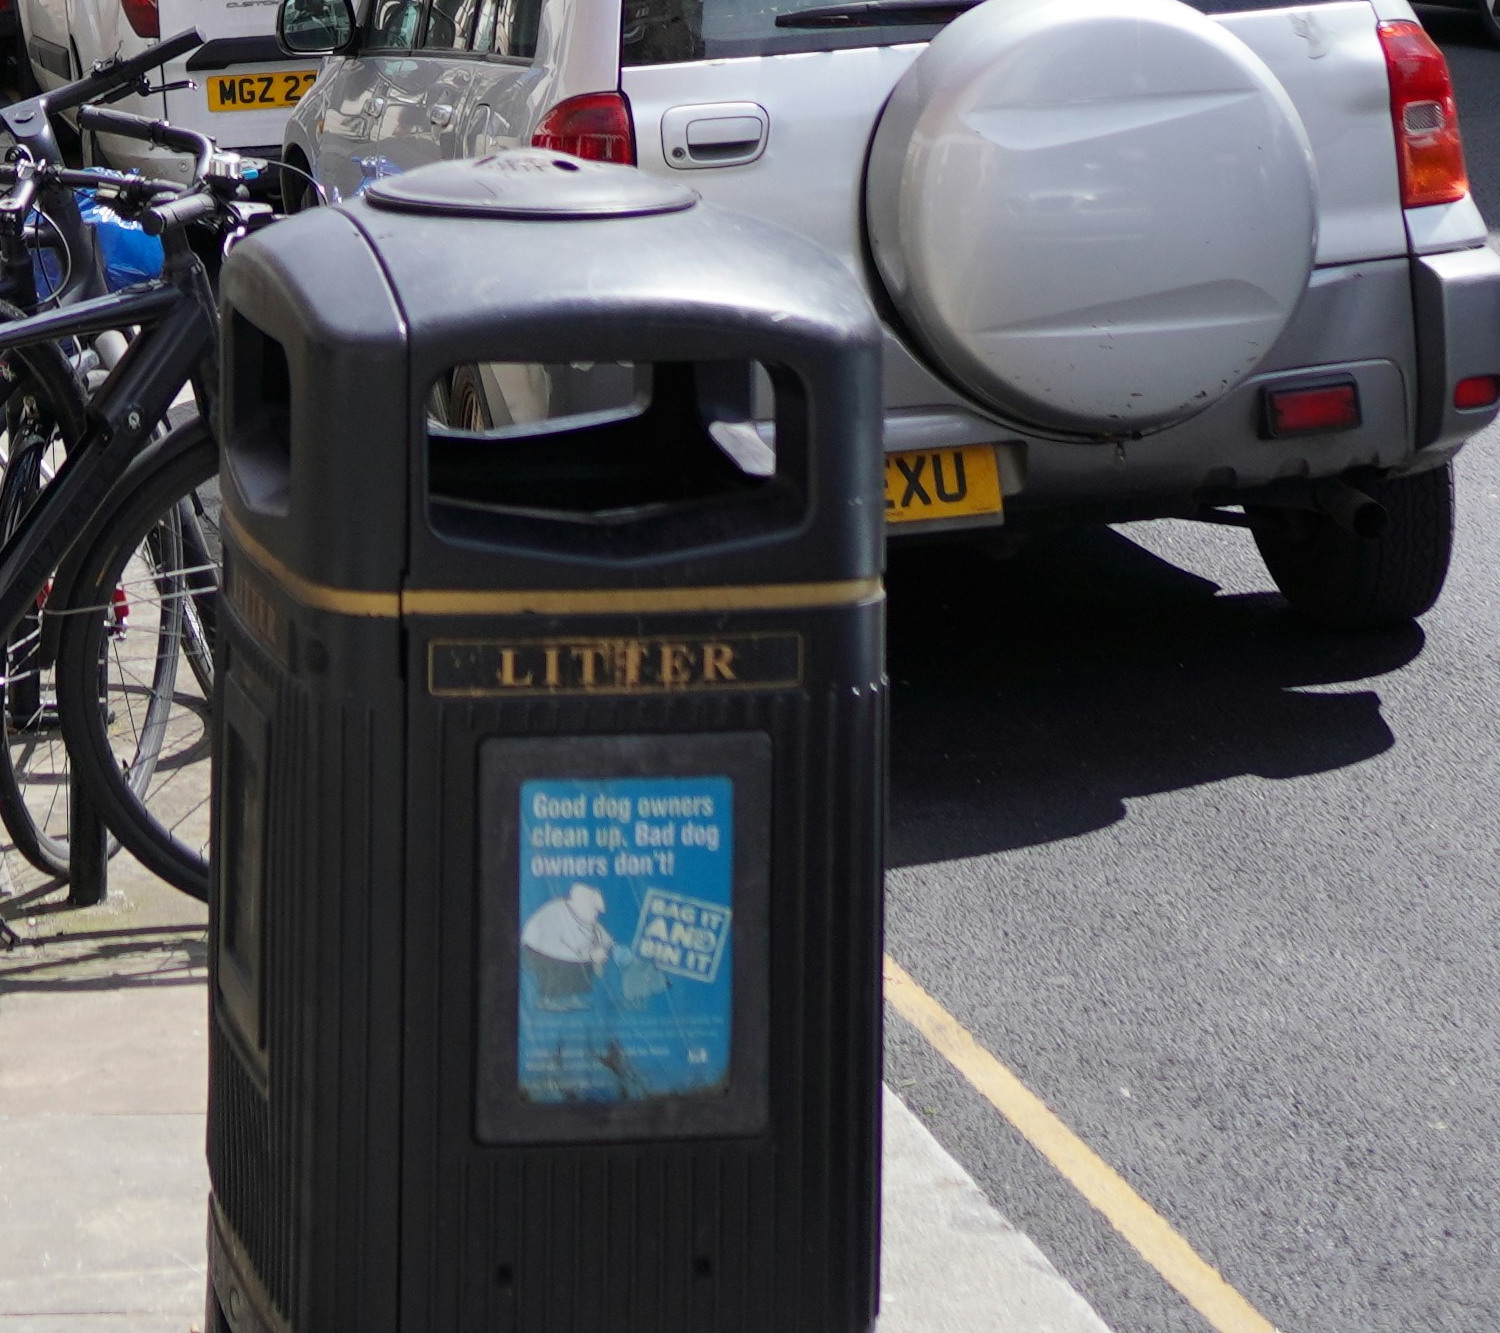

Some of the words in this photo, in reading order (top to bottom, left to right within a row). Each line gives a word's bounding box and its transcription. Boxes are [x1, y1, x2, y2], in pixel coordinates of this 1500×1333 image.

[218, 76, 275, 105] MGZ
[496, 641, 738, 688] LITTER
[533, 792, 586, 820] Good
[592, 793, 632, 824] dog
[637, 794, 714, 819] owners
[531, 824, 589, 848] clean
[595, 827, 628, 852] up.
[634, 821, 675, 847] Bad
[680, 822, 720, 852] dog
[531, 854, 608, 877] owners
[614, 851, 675, 876] don't!
[650, 897, 697, 923] BAG
[700, 909, 724, 932] IT
[644, 917, 718, 954] AND
[639, 939, 683, 966] BIN
[685, 951, 712, 975] IT
